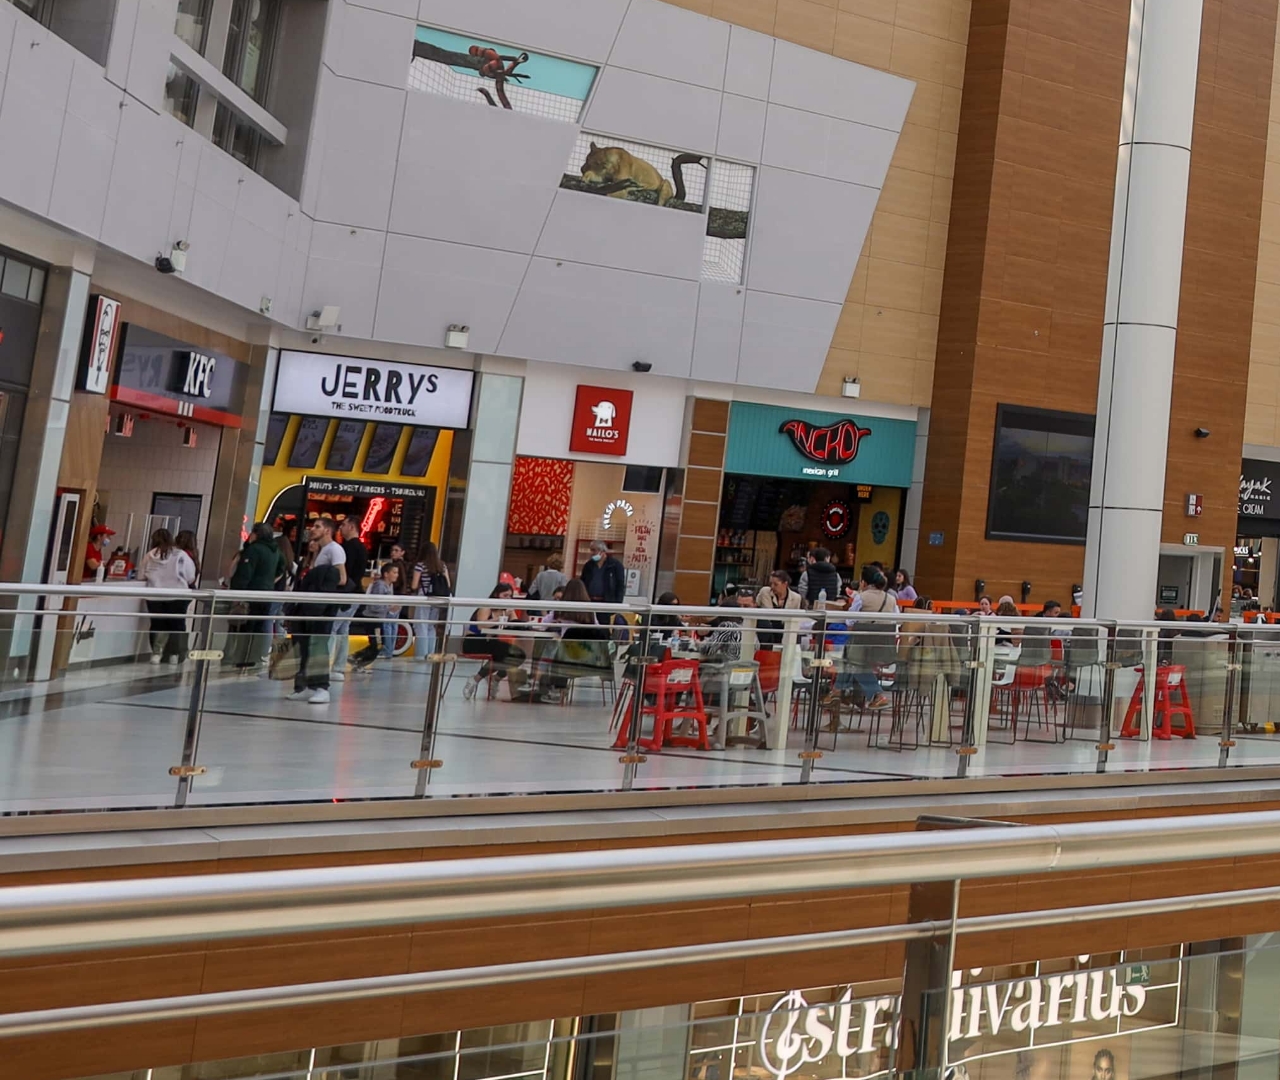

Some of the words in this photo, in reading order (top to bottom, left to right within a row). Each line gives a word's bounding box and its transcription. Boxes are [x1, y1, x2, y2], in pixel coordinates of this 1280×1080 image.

[183, 351, 217, 398] KFC
[331, 401, 346, 411] THE
[348, 403, 373, 414] SWEET
[374, 406, 417, 417] FOODTRUCK
[802, 466, 826, 476] mexican
[827, 468, 840, 478] grill
[339, 482, 360, 493] SWEET
[1239, 474, 1272, 500] ayak
[616, 499, 634, 517] PASTA
[804, 954, 1147, 1063] strivarius
